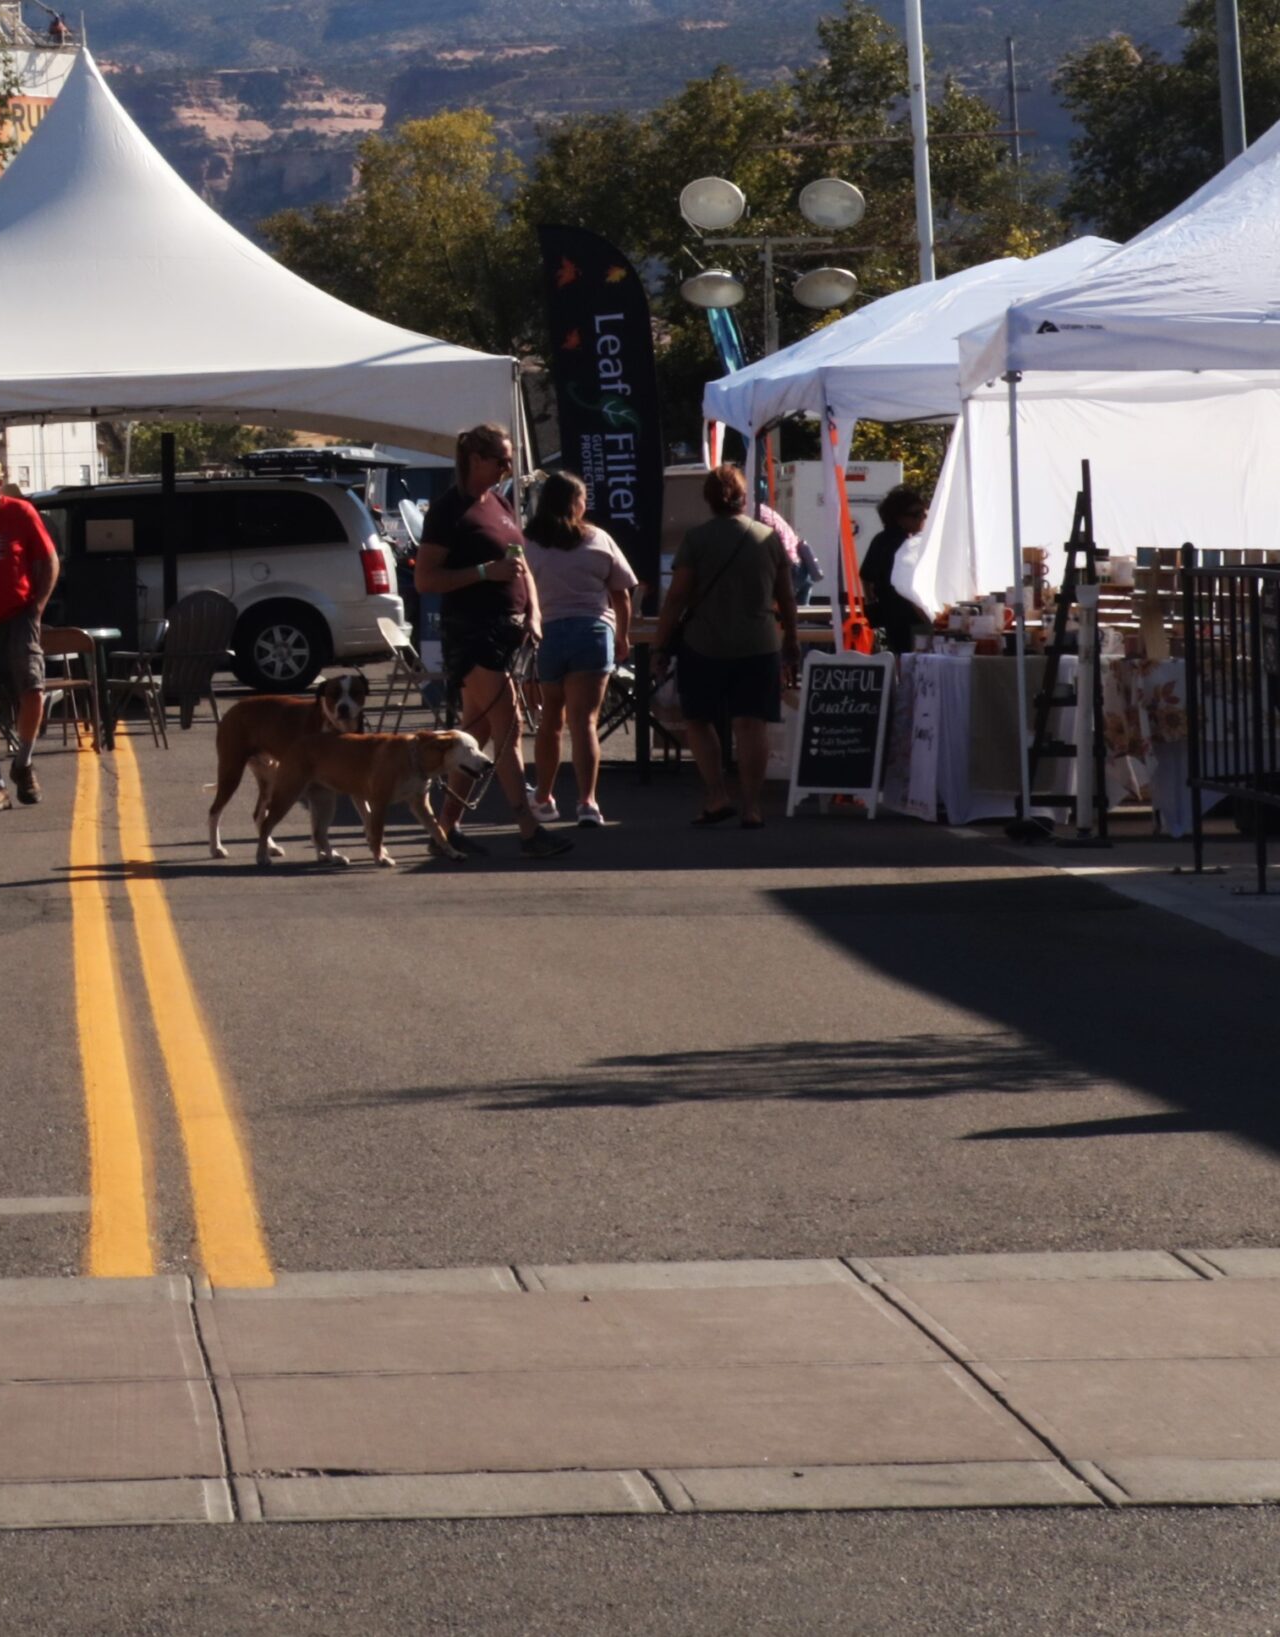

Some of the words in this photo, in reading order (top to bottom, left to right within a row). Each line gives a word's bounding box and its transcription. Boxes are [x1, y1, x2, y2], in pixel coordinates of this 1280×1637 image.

[594, 312, 632, 396] Leaf
[581, 434, 596, 511] PROTECTION
[592, 434, 605, 481] GUTTER
[604, 433, 637, 526] Filter
[811, 668, 882, 692] BASHFUL
